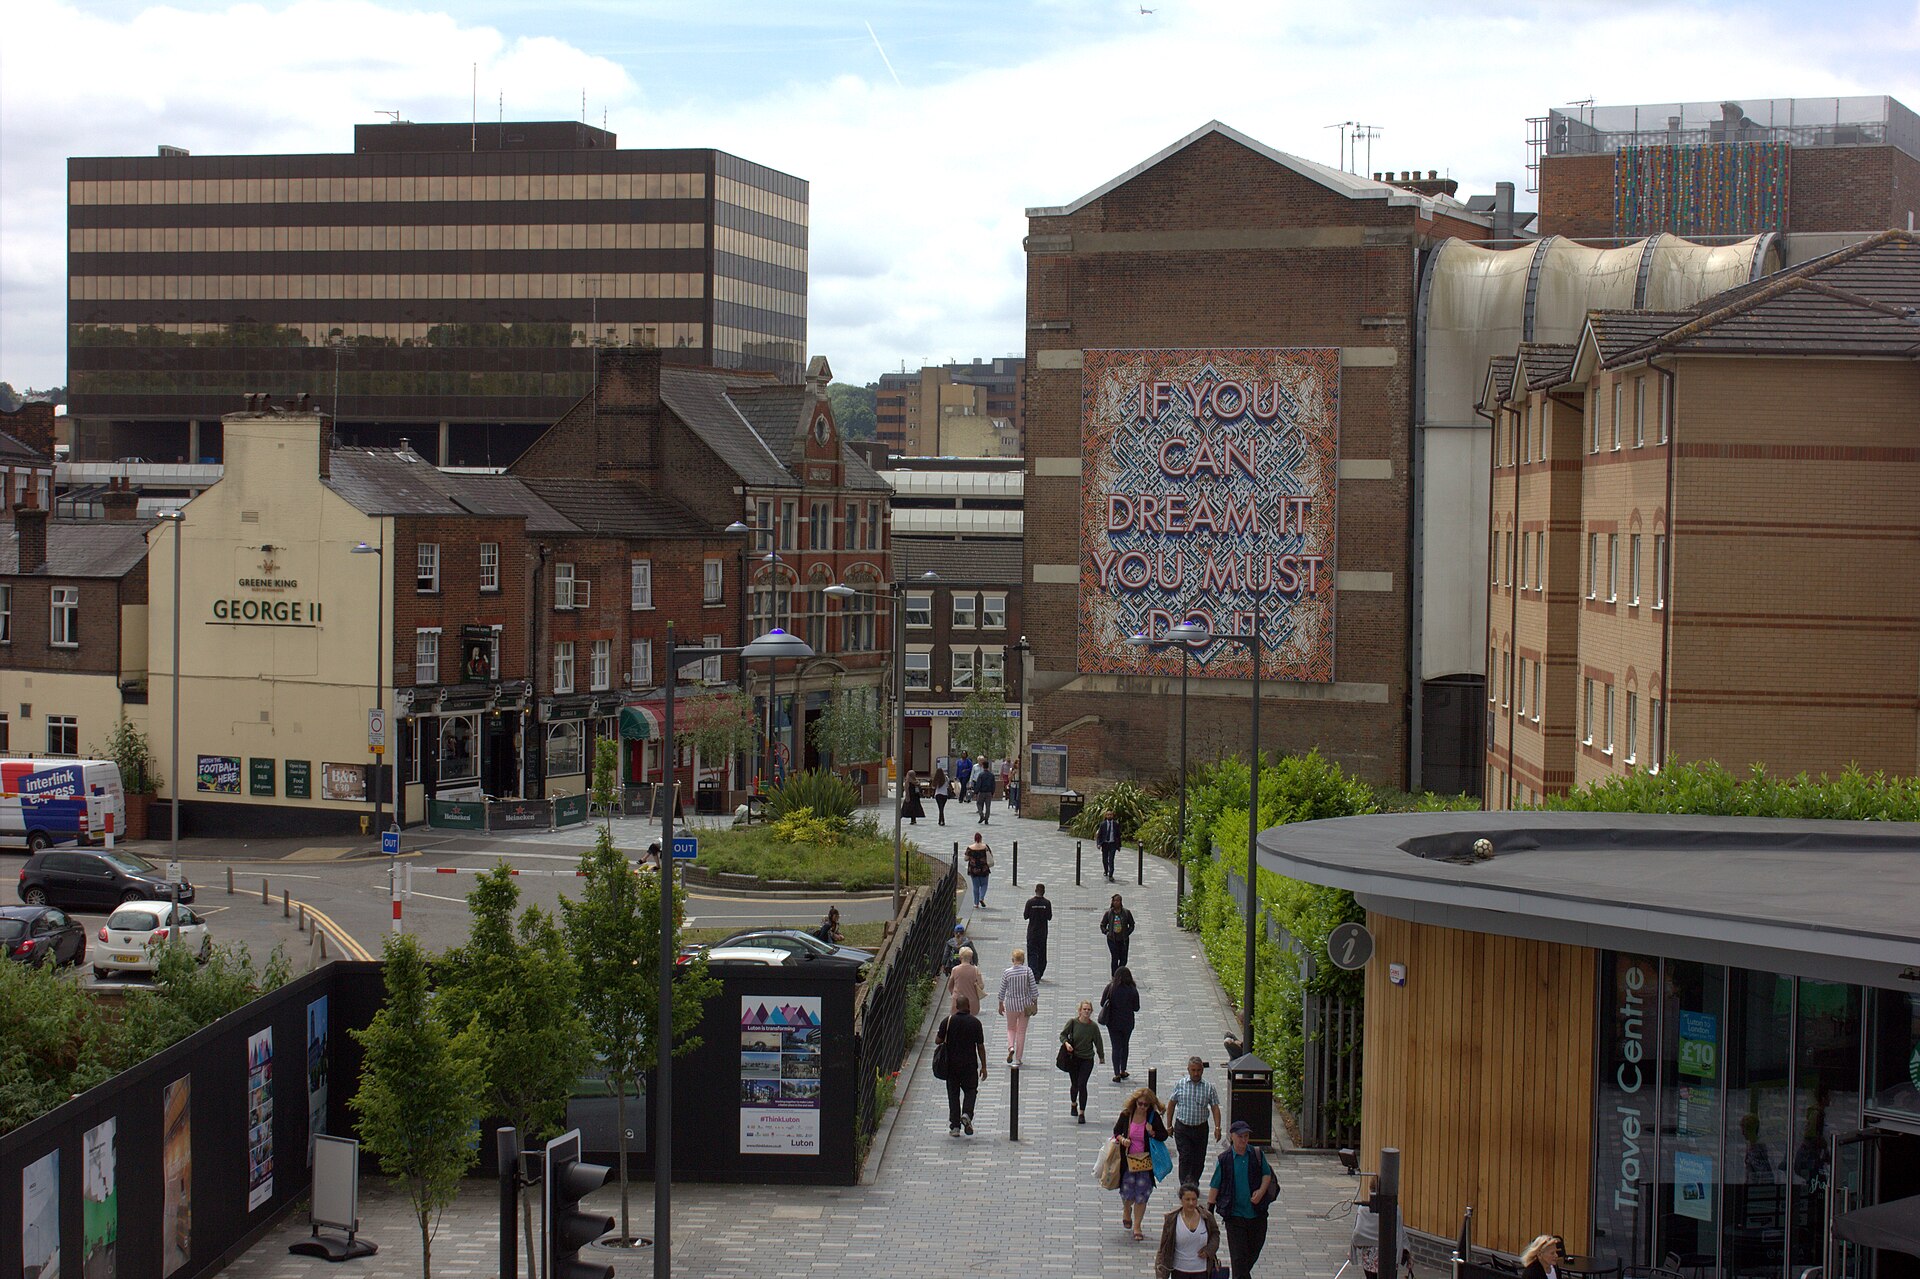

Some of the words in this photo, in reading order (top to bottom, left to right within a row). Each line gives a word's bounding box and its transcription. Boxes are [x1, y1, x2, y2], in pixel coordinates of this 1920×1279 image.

[1139, 380, 1171, 420] IF
[1186, 379, 1280, 420] YOU
[1158, 437, 1257, 479] CAN
[1107, 494, 1259, 535] DREAM
[1279, 495, 1311, 536] IT
[1092, 551, 1186, 590] YOU
[1202, 554, 1323, 593] MUST
[238, 578, 272, 587] GREENE
[274, 579, 298, 588] KING
[213, 600, 302, 621] GEORGE
[309, 602, 322, 622] II
[1233, 610, 1264, 648] IT
[199, 762, 240, 775] FOOTBALL
[26, 769, 75, 792] interlink
[217, 772, 238, 784] HERE
[332, 769, 358, 783] B&B
[30, 784, 76, 805] express
[444, 813, 471, 821] Heineken
[384, 838, 397, 848] OUT
[674, 844, 694, 853] OUT
[1686, 1017, 1704, 1027] Luton
[1617, 966, 1644, 1094] Centre
[1687, 1025, 1710, 1034] London
[1681, 1041, 1714, 1065] £10
[760, 1115, 800, 1123] #ThinkLuton
[791, 1139, 814, 1147] Luton
[1614, 1106, 1641, 1211] Travel
[1679, 1157, 1704, 1169] Visiting
[1679, 1165, 1706, 1176] London?
